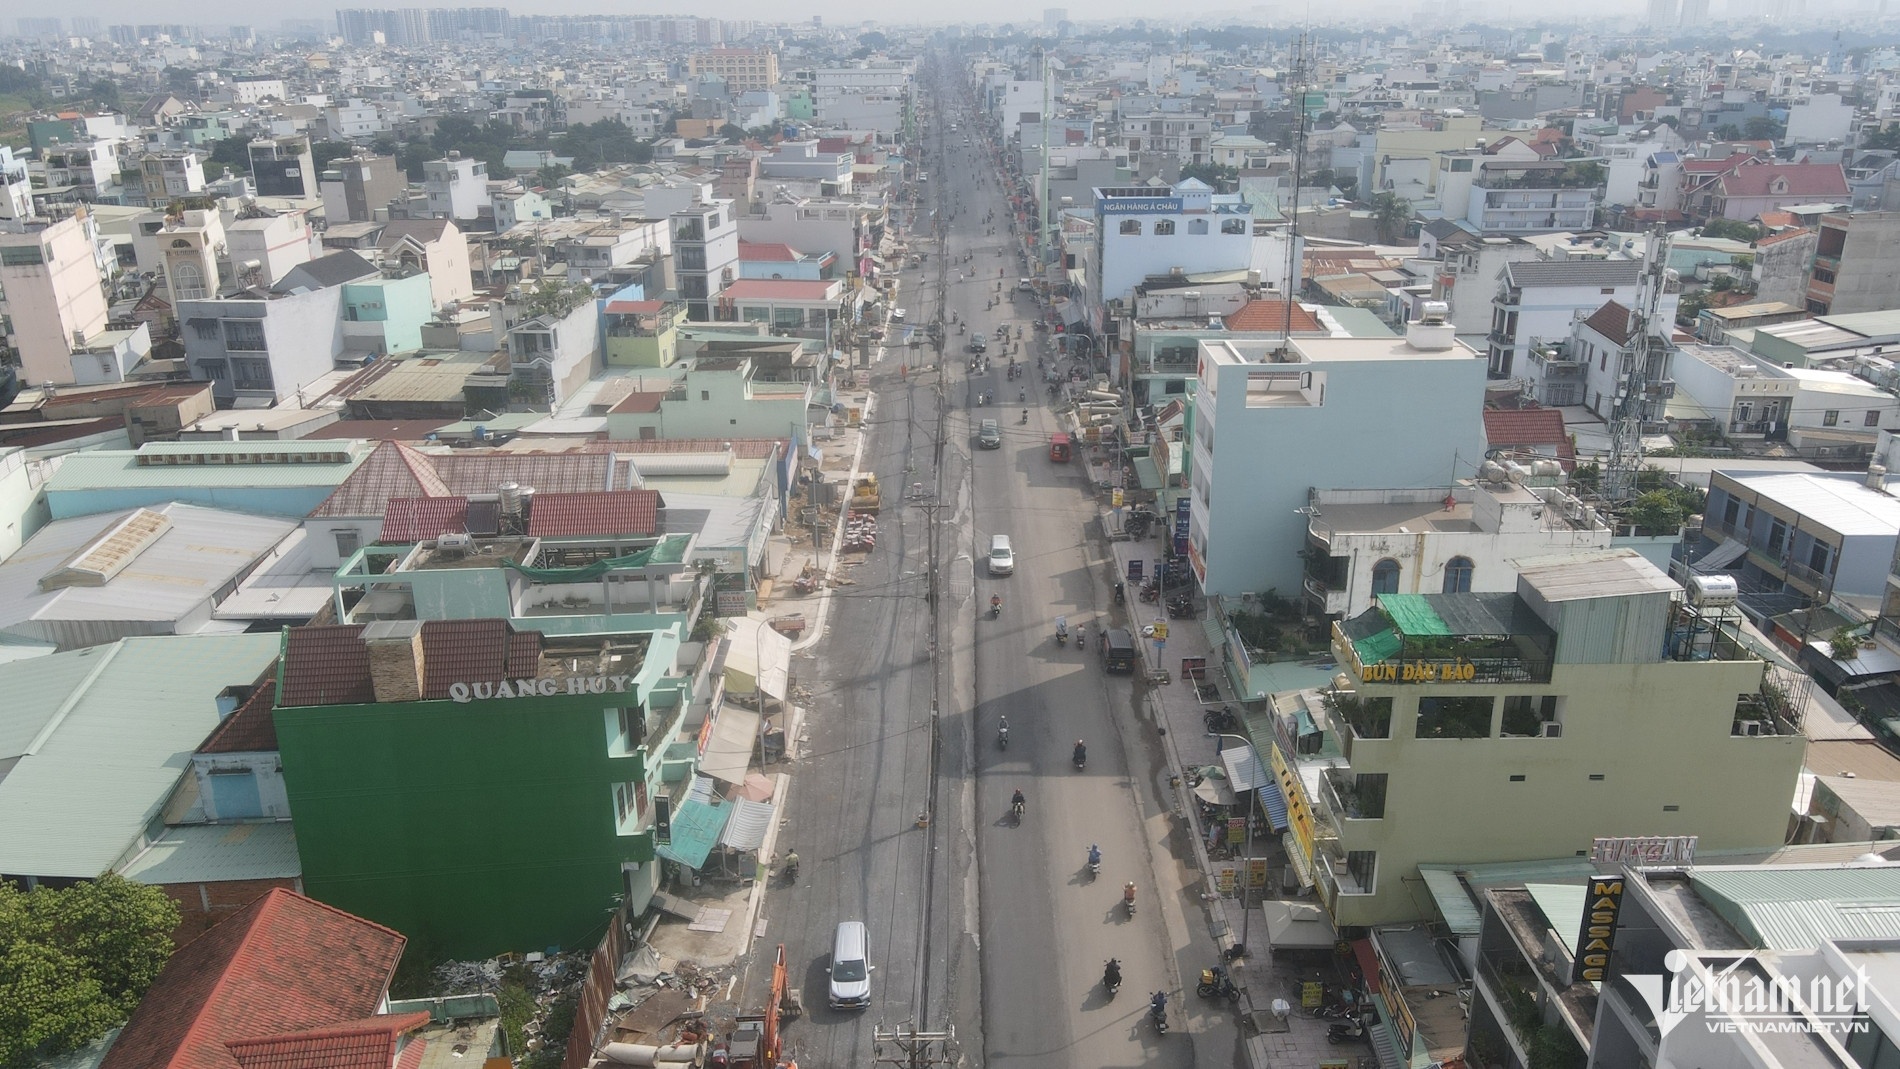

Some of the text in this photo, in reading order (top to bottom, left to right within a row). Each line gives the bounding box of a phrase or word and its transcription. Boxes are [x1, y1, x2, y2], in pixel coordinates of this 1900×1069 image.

[1104, 202, 1178, 211] NGÂN HÀNG Á CHÂU
[1363, 656, 1475, 685] BÚN ĐẬU BẢO
[449, 675, 630, 703] QUANG HUY
[1583, 882, 1622, 981] MASSAGE
